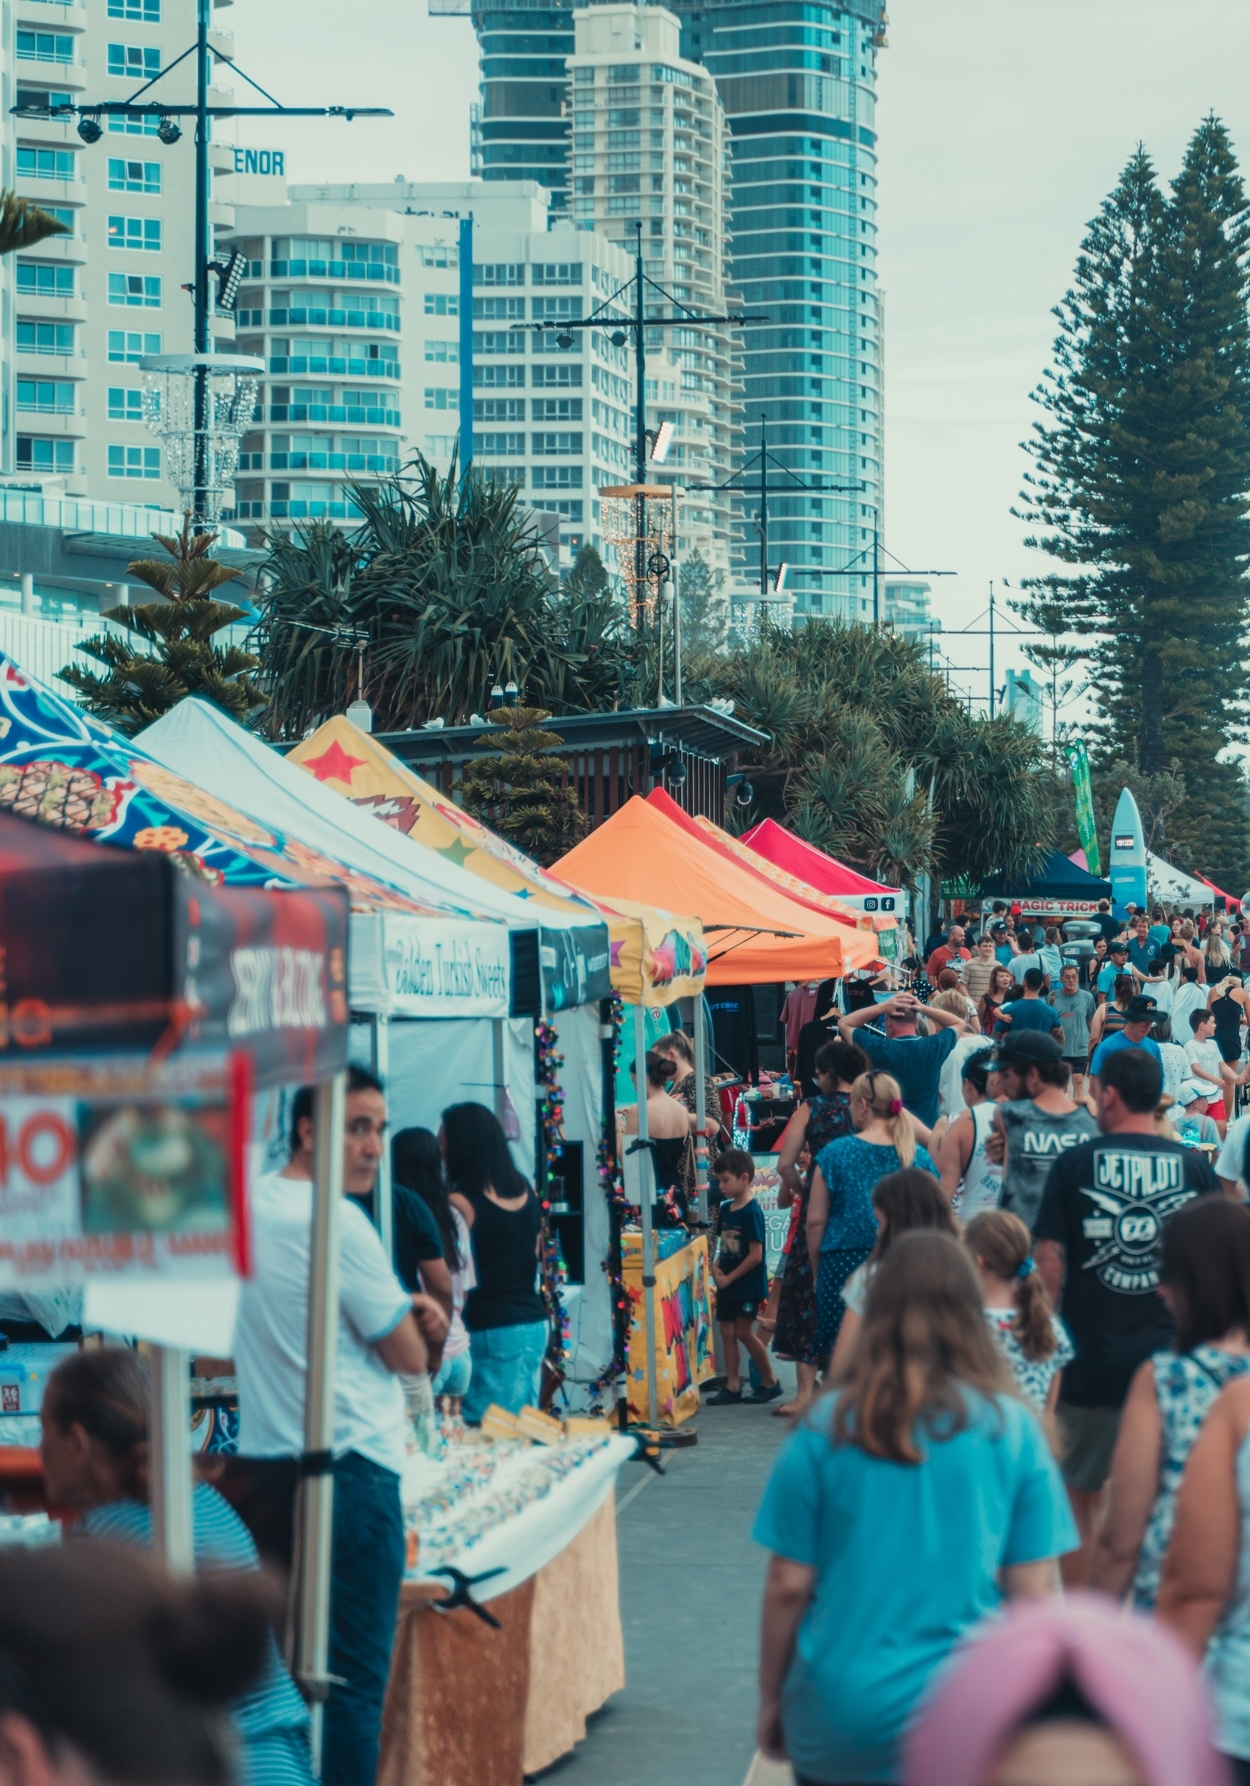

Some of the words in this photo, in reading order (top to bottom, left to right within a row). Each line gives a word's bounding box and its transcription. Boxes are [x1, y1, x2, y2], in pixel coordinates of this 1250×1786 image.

[1058, 902, 1100, 912] TRICK
[435, 939, 474, 997] Turkish
[474, 947, 506, 999] Sweets
[1024, 1131, 1091, 1153] NASA
[980, 1175, 999, 1192] BAR
[1100, 1154, 1180, 1196] JETPILOT
[1104, 1266, 1160, 1291] COMPAN
